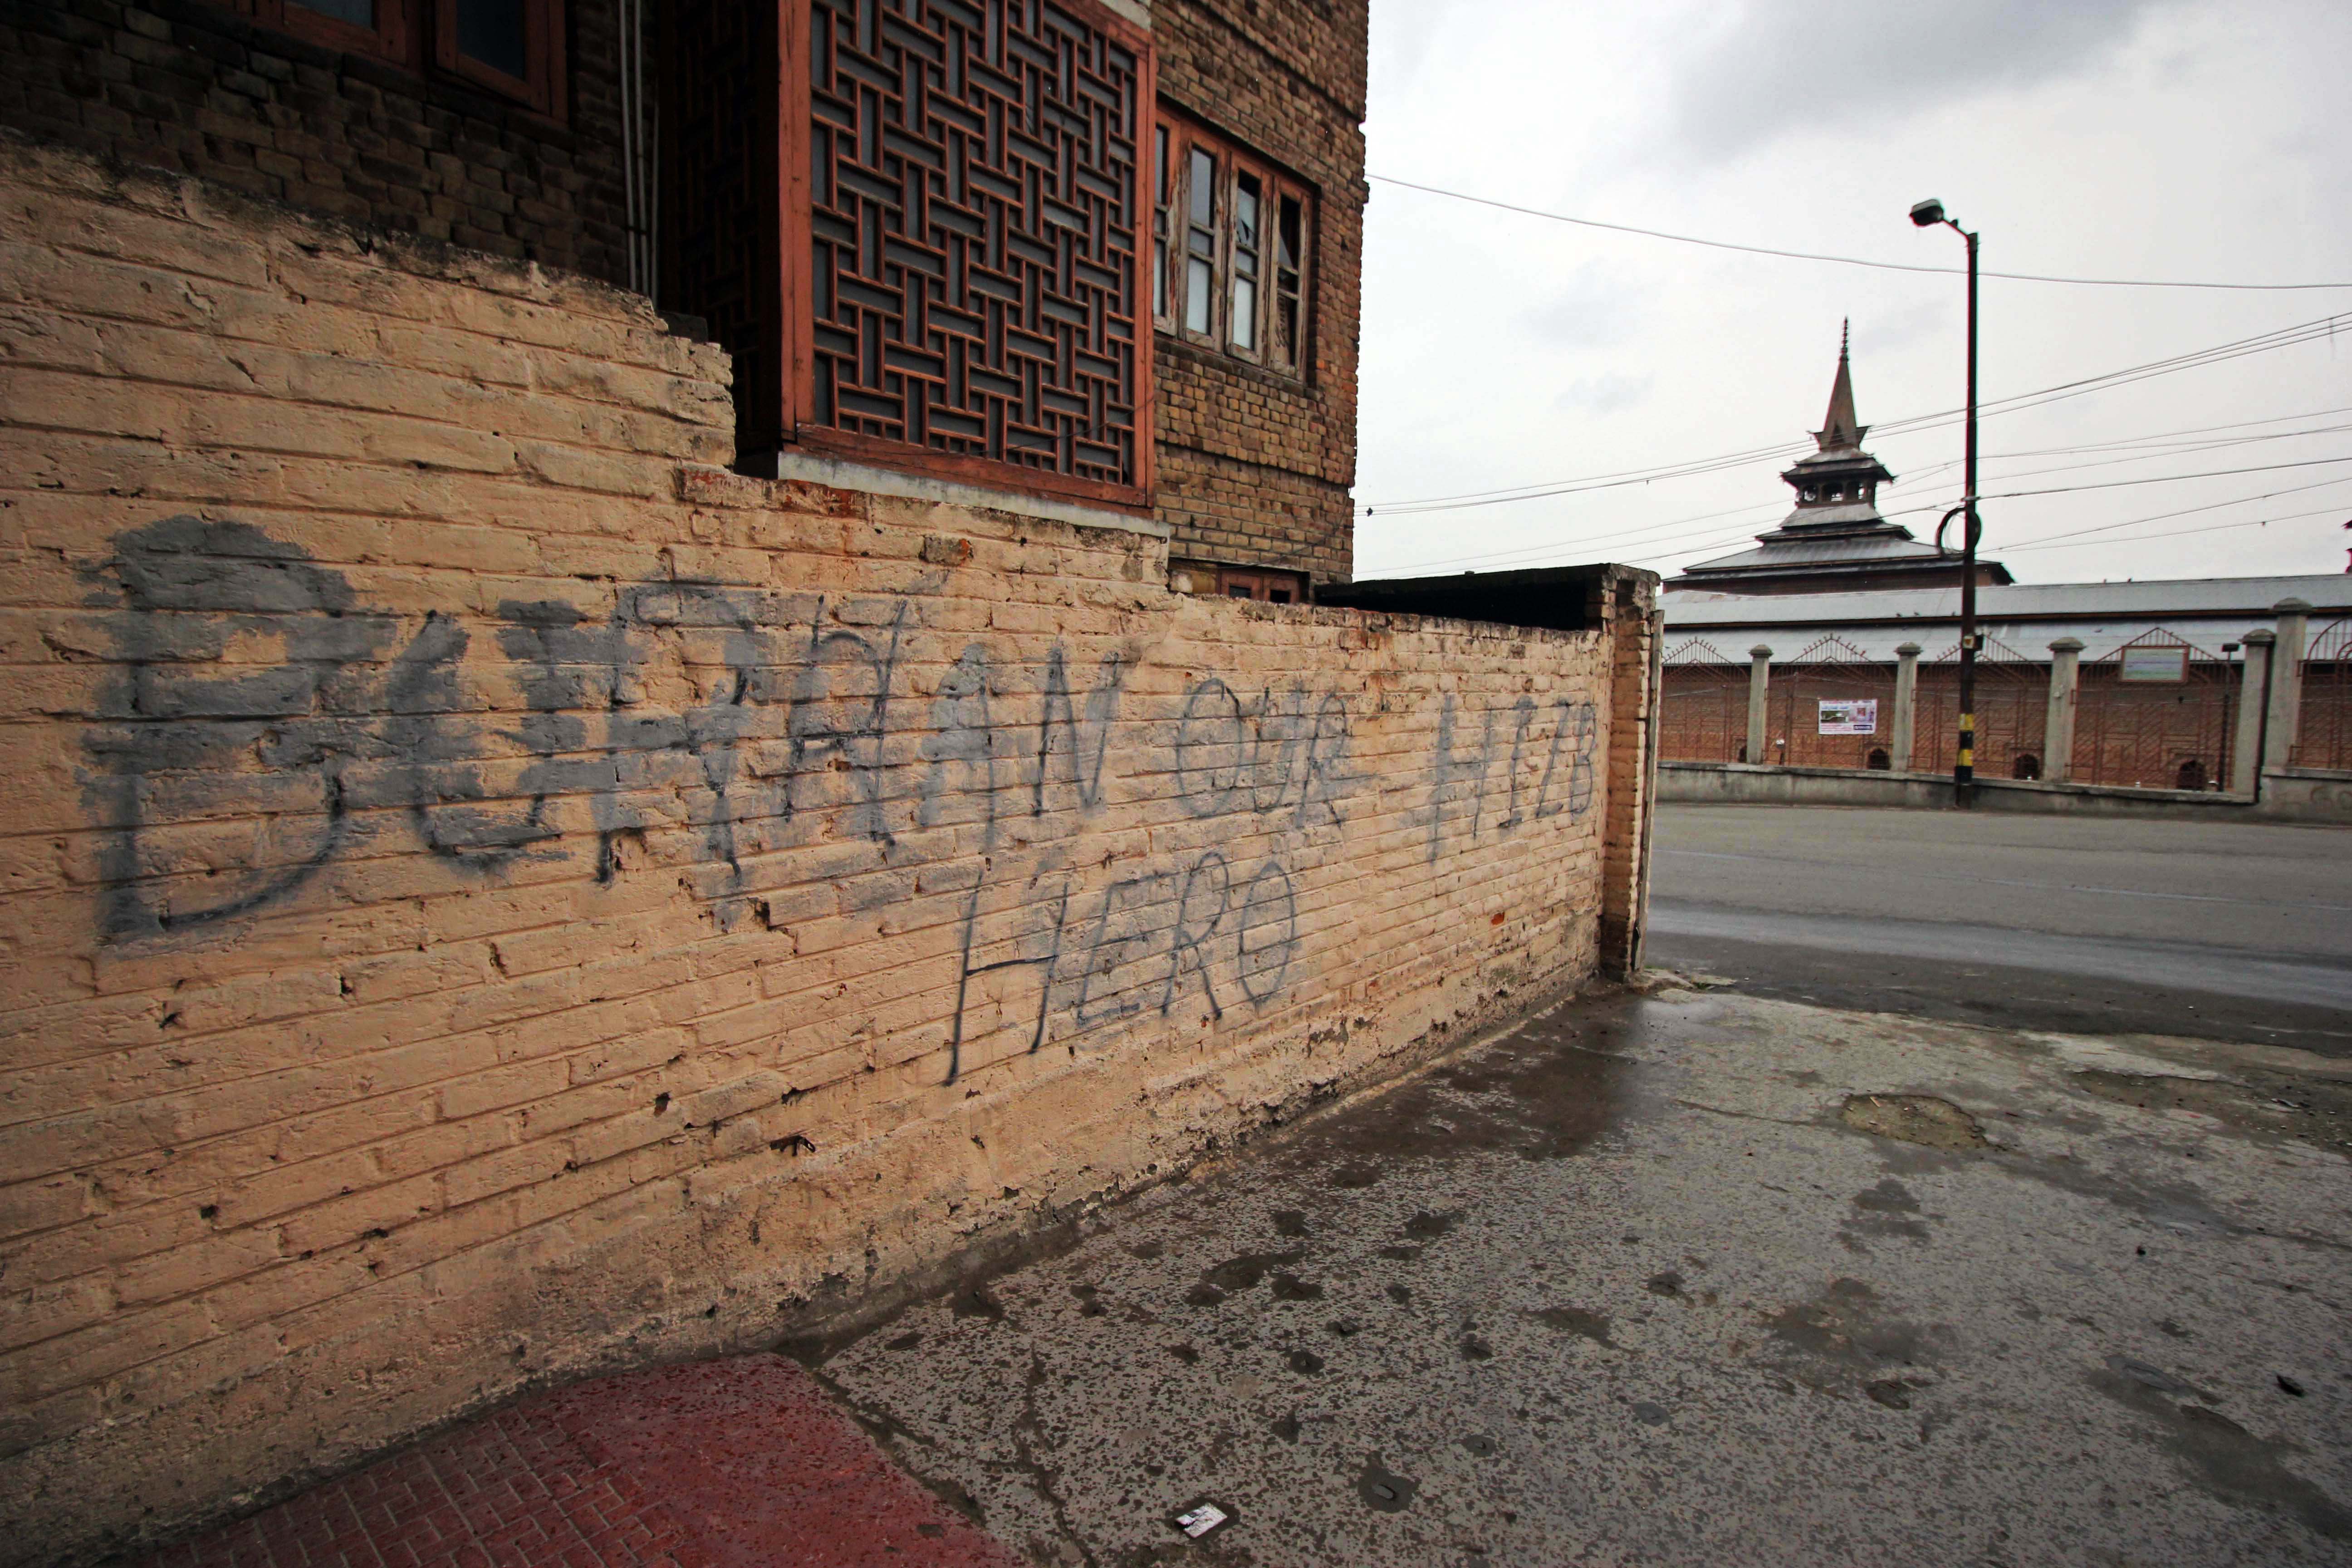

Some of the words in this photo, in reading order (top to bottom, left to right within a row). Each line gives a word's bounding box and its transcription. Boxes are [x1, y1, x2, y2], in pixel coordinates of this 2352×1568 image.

[1175, 677, 1348, 830] OUR
[1426, 693, 1597, 867] HIZB
[944, 852, 1296, 1087] HERO
